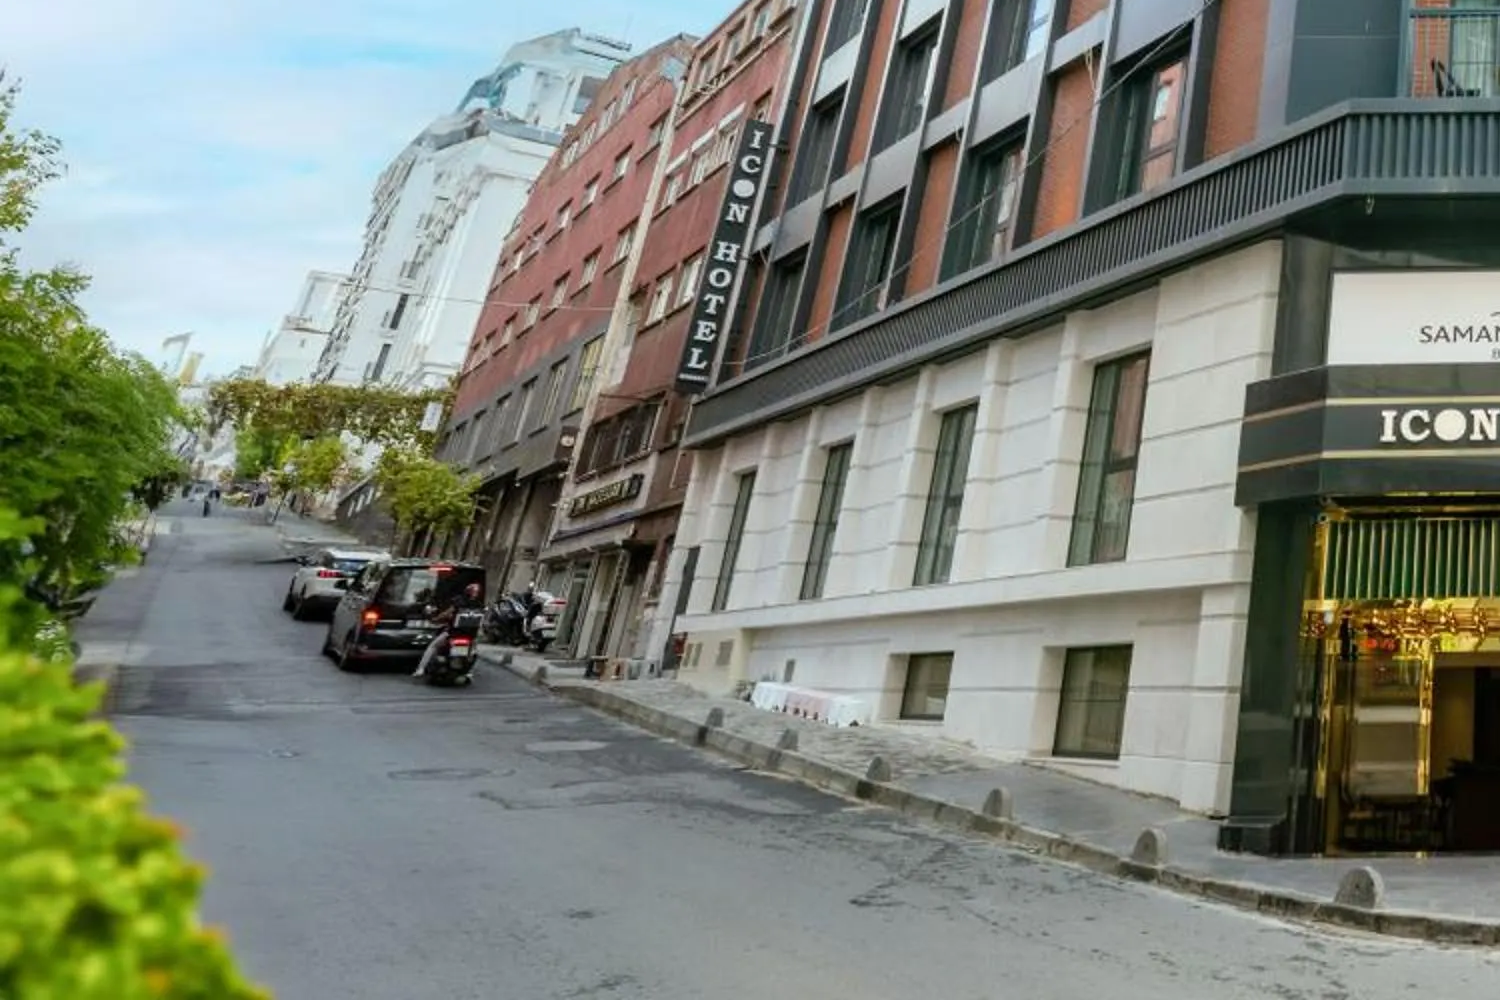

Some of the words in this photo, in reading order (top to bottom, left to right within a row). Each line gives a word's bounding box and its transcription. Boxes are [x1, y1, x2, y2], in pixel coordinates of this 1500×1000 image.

[725, 129, 764, 223] ICON
[687, 240, 740, 370] HOTEL
[1380, 408, 1500, 442] ICON
